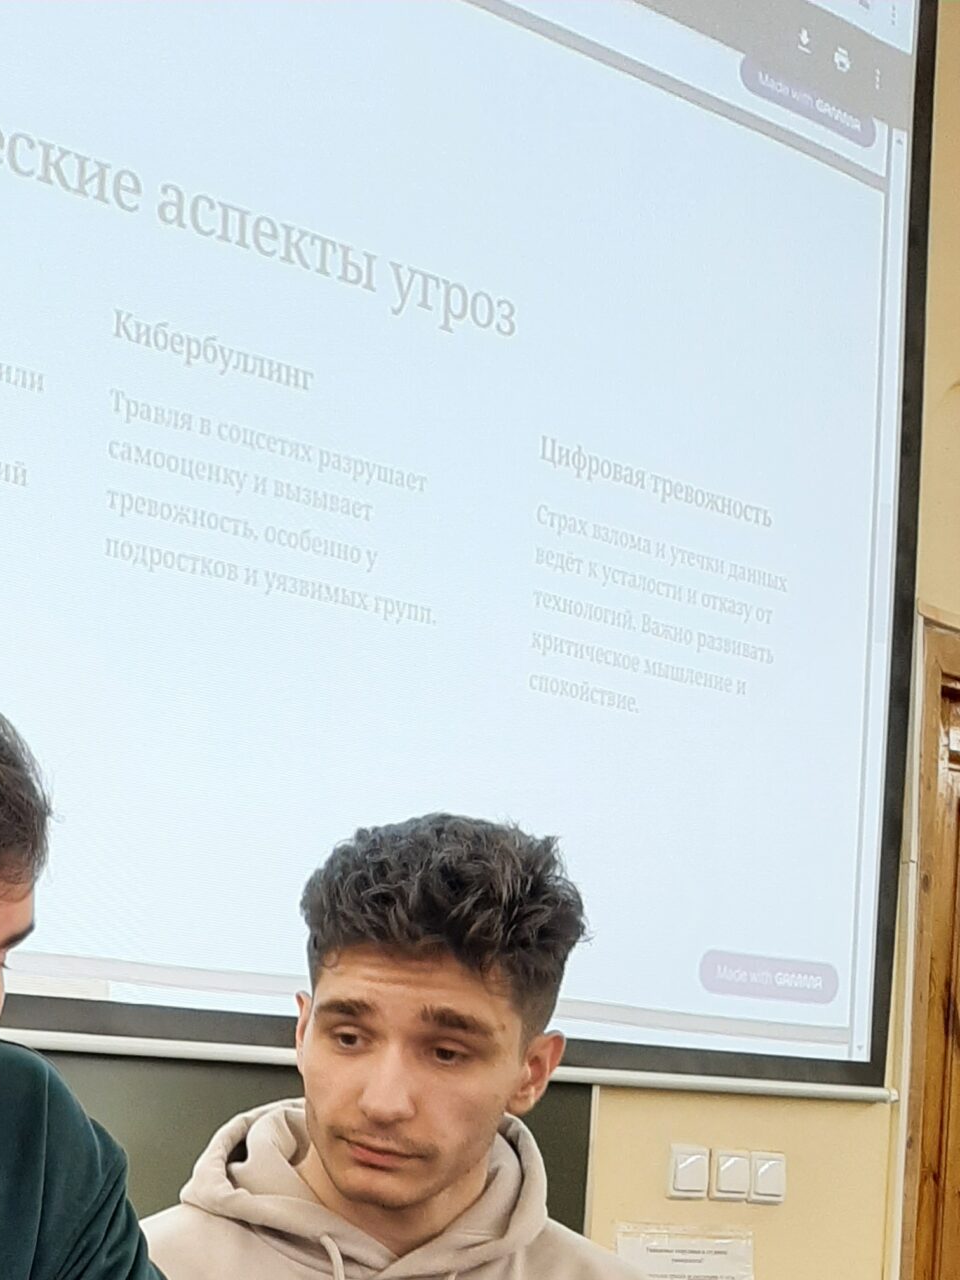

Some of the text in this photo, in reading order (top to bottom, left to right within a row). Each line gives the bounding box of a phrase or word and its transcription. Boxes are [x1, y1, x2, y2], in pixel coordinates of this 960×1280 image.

[157, 184, 377, 292] аспекты
[387, 259, 517, 337] угроз
[114, 309, 314, 390] Кибербуллинг
[109, 441, 373, 521] самооценку и вызывает
[110, 389, 427, 492] Травля в соцсетях разрушает
[541, 435, 772, 527] Цифровая тревожность
[107, 490, 378, 573] тревожность, особенно у
[537, 505, 787, 592] Страх взлома и утечки данных
[105, 538, 436, 624] подростков и уязвимых групп.
[536, 548, 773, 624] ведёт к усталости и отказу от
[531, 632, 746, 695] критическое мышление и
[533, 591, 774, 664] технологий. Важно развивать
[529, 675, 639, 713] спокойствие.
